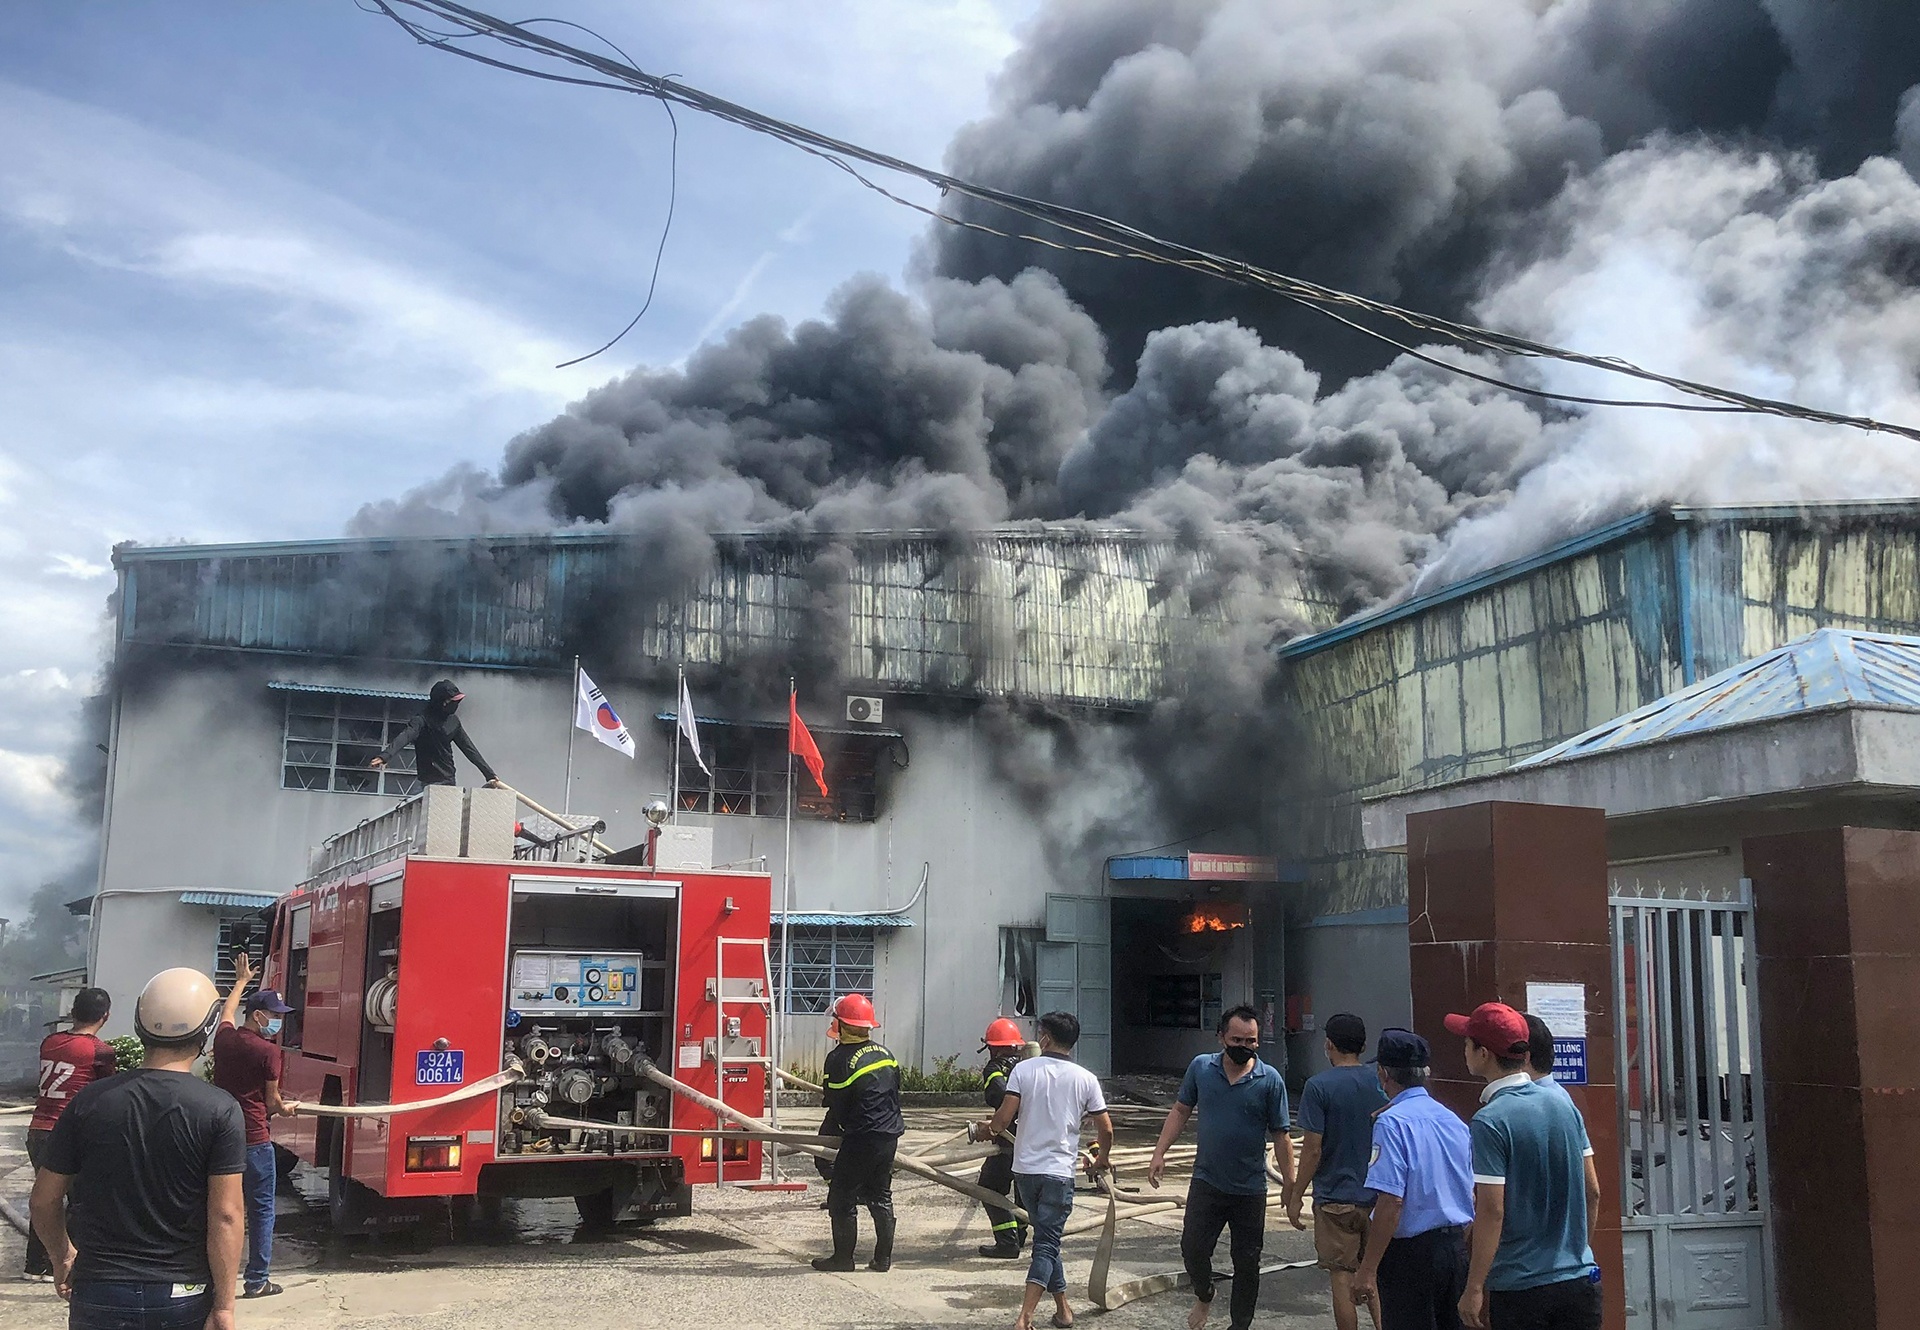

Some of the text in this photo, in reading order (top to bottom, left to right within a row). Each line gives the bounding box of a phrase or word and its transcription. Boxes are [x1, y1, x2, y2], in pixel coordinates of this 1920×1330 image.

[1552, 1042, 1581, 1053] UI LÒNG
[428, 1052, 453, 1067] 92A
[39, 1060, 76, 1099] 22
[418, 1067, 462, 1083] 006.14
[628, 1202, 678, 1212] MRITA
[363, 1215, 420, 1225] MRITA
